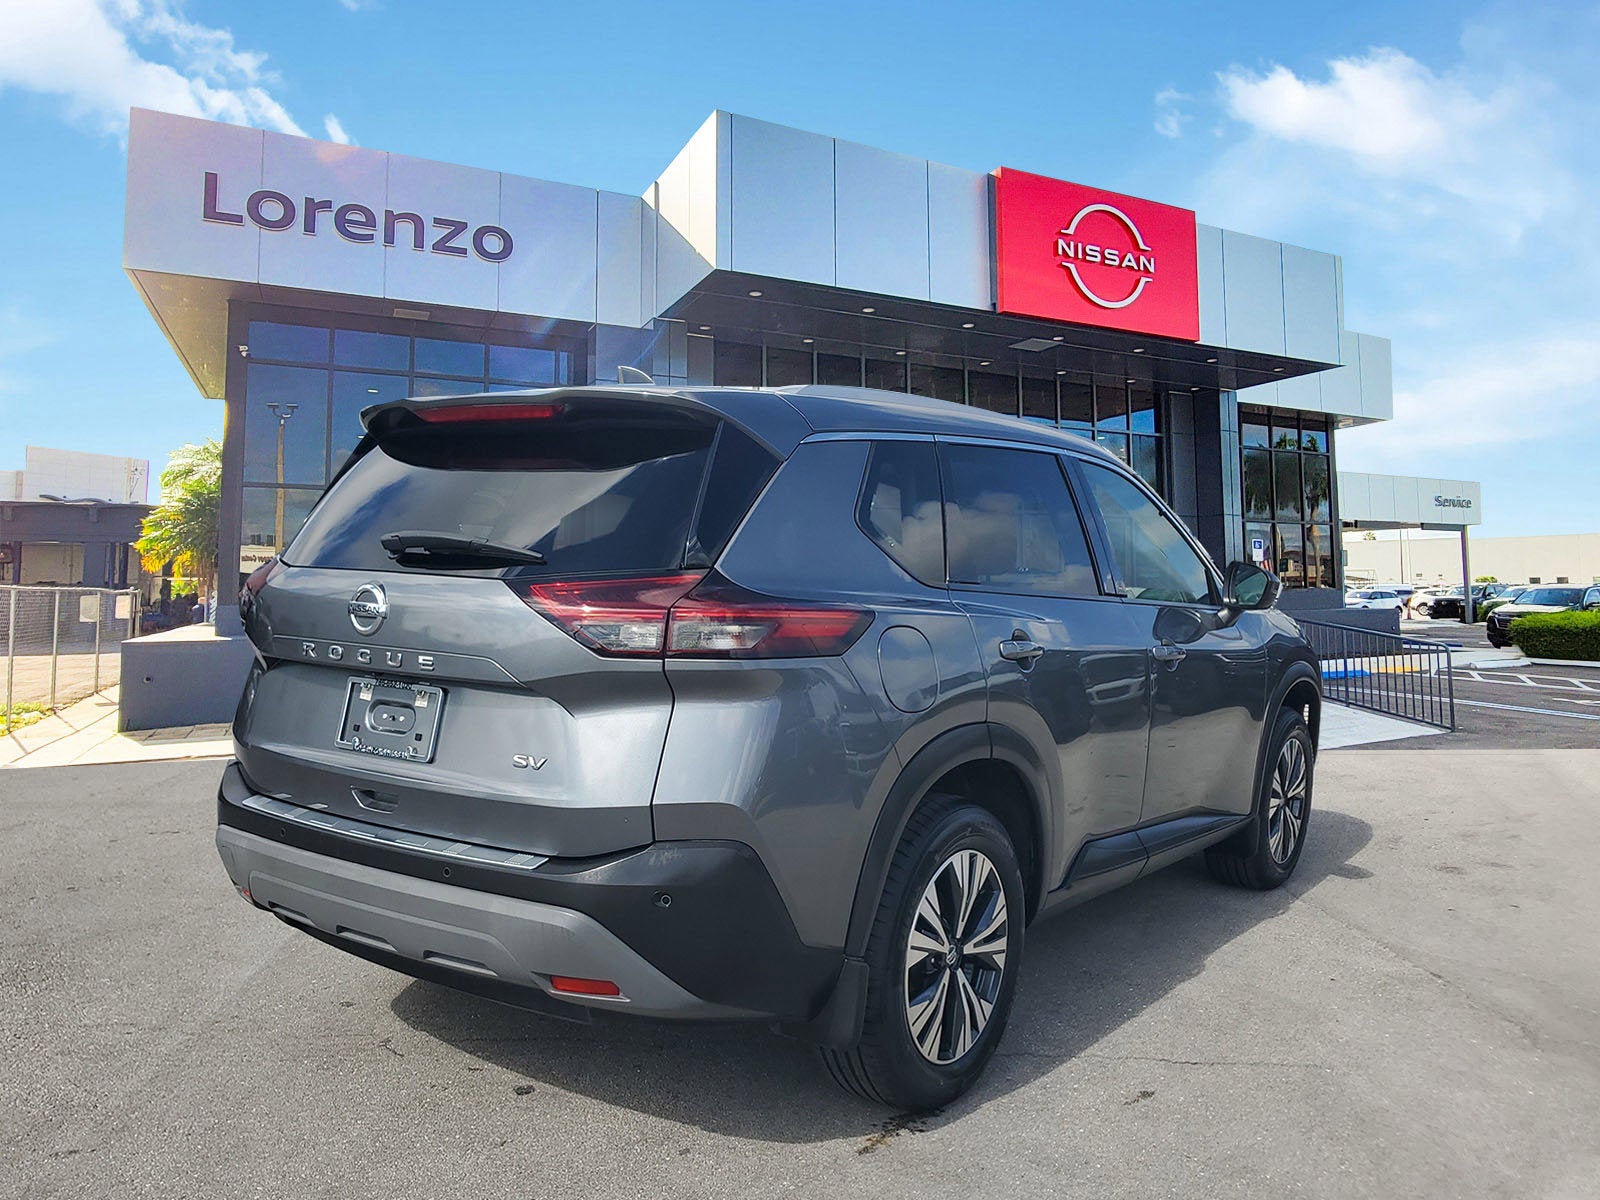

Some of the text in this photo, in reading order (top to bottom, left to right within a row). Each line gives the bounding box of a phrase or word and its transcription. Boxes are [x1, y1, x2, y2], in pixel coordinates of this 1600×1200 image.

[202, 171, 515, 262] Lorenzo
[1057, 237, 1156, 273] NISSAN
[1434, 495, 1472, 508] Service
[302, 642, 435, 672] ROGUE
[512, 754, 548, 771] SV
